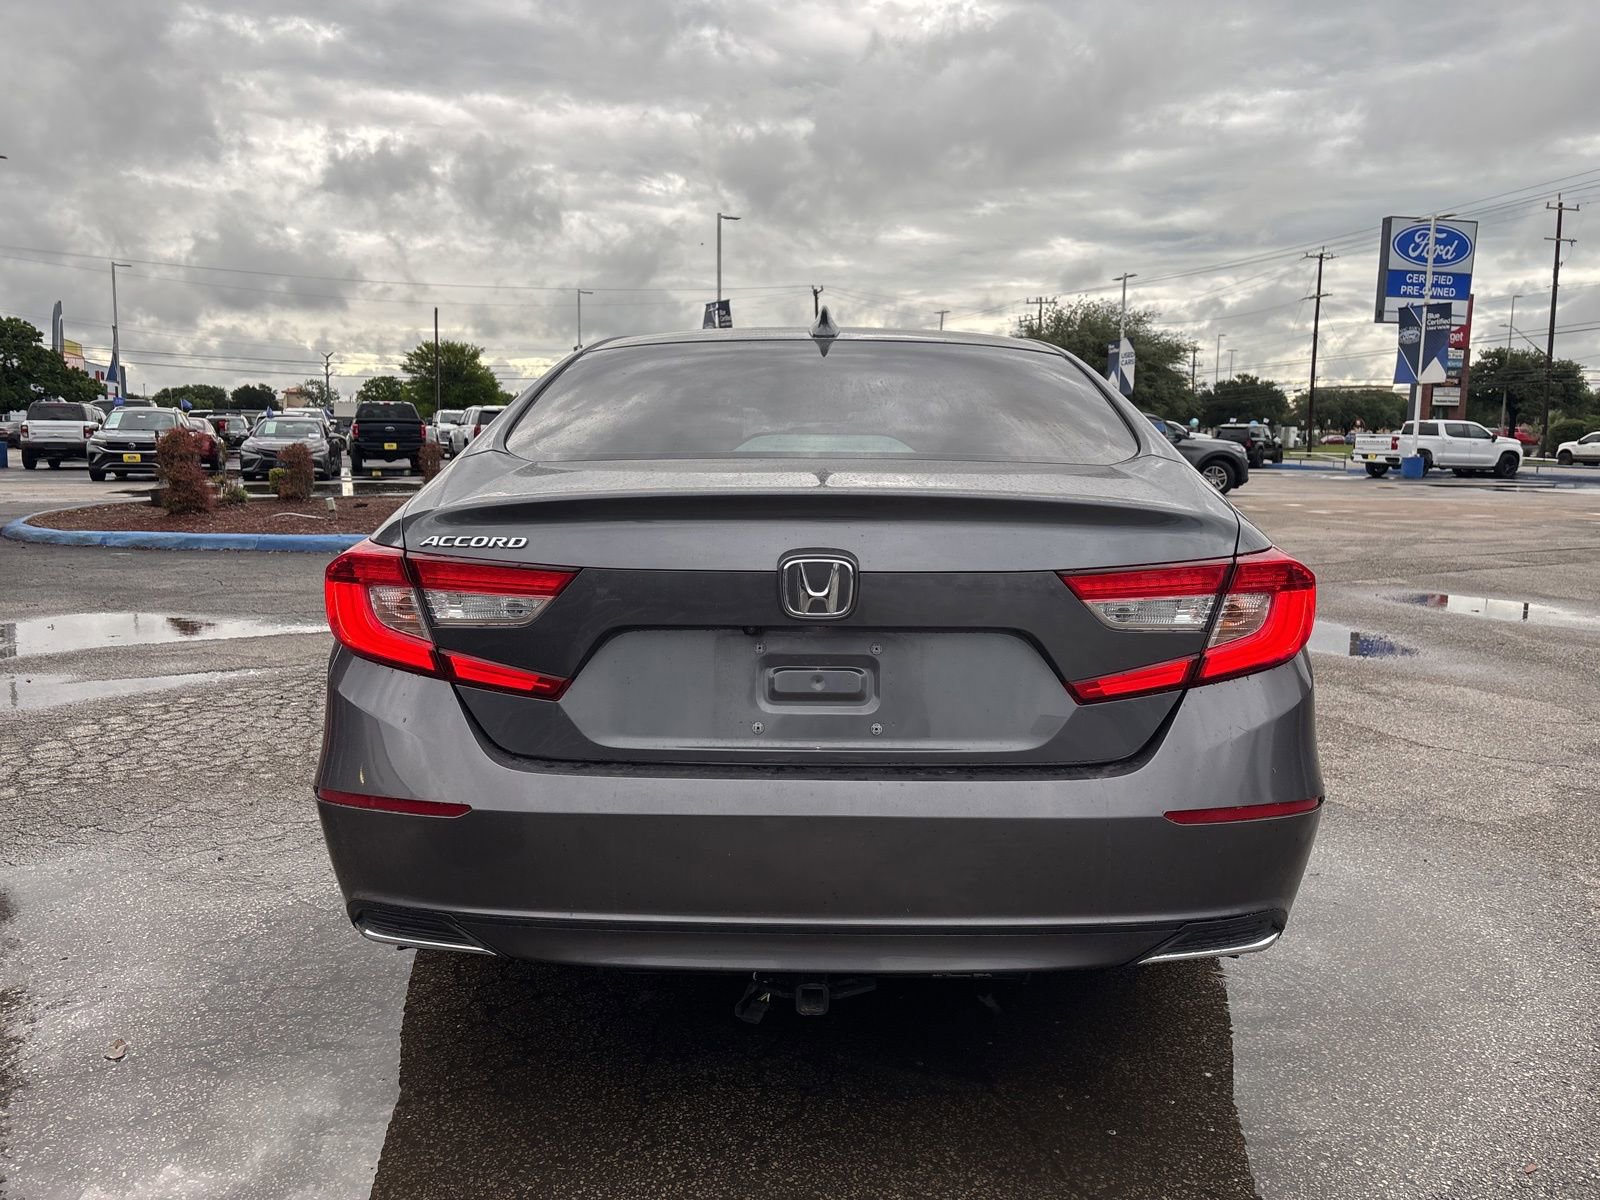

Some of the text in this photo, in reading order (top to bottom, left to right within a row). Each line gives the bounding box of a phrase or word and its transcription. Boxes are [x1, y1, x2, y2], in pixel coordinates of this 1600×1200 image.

[1408, 230, 1458, 260] Ford
[1406, 273, 1454, 285] CERFIED
[1427, 318, 1451, 326] Certified
[420, 535, 528, 548] ACCORD
